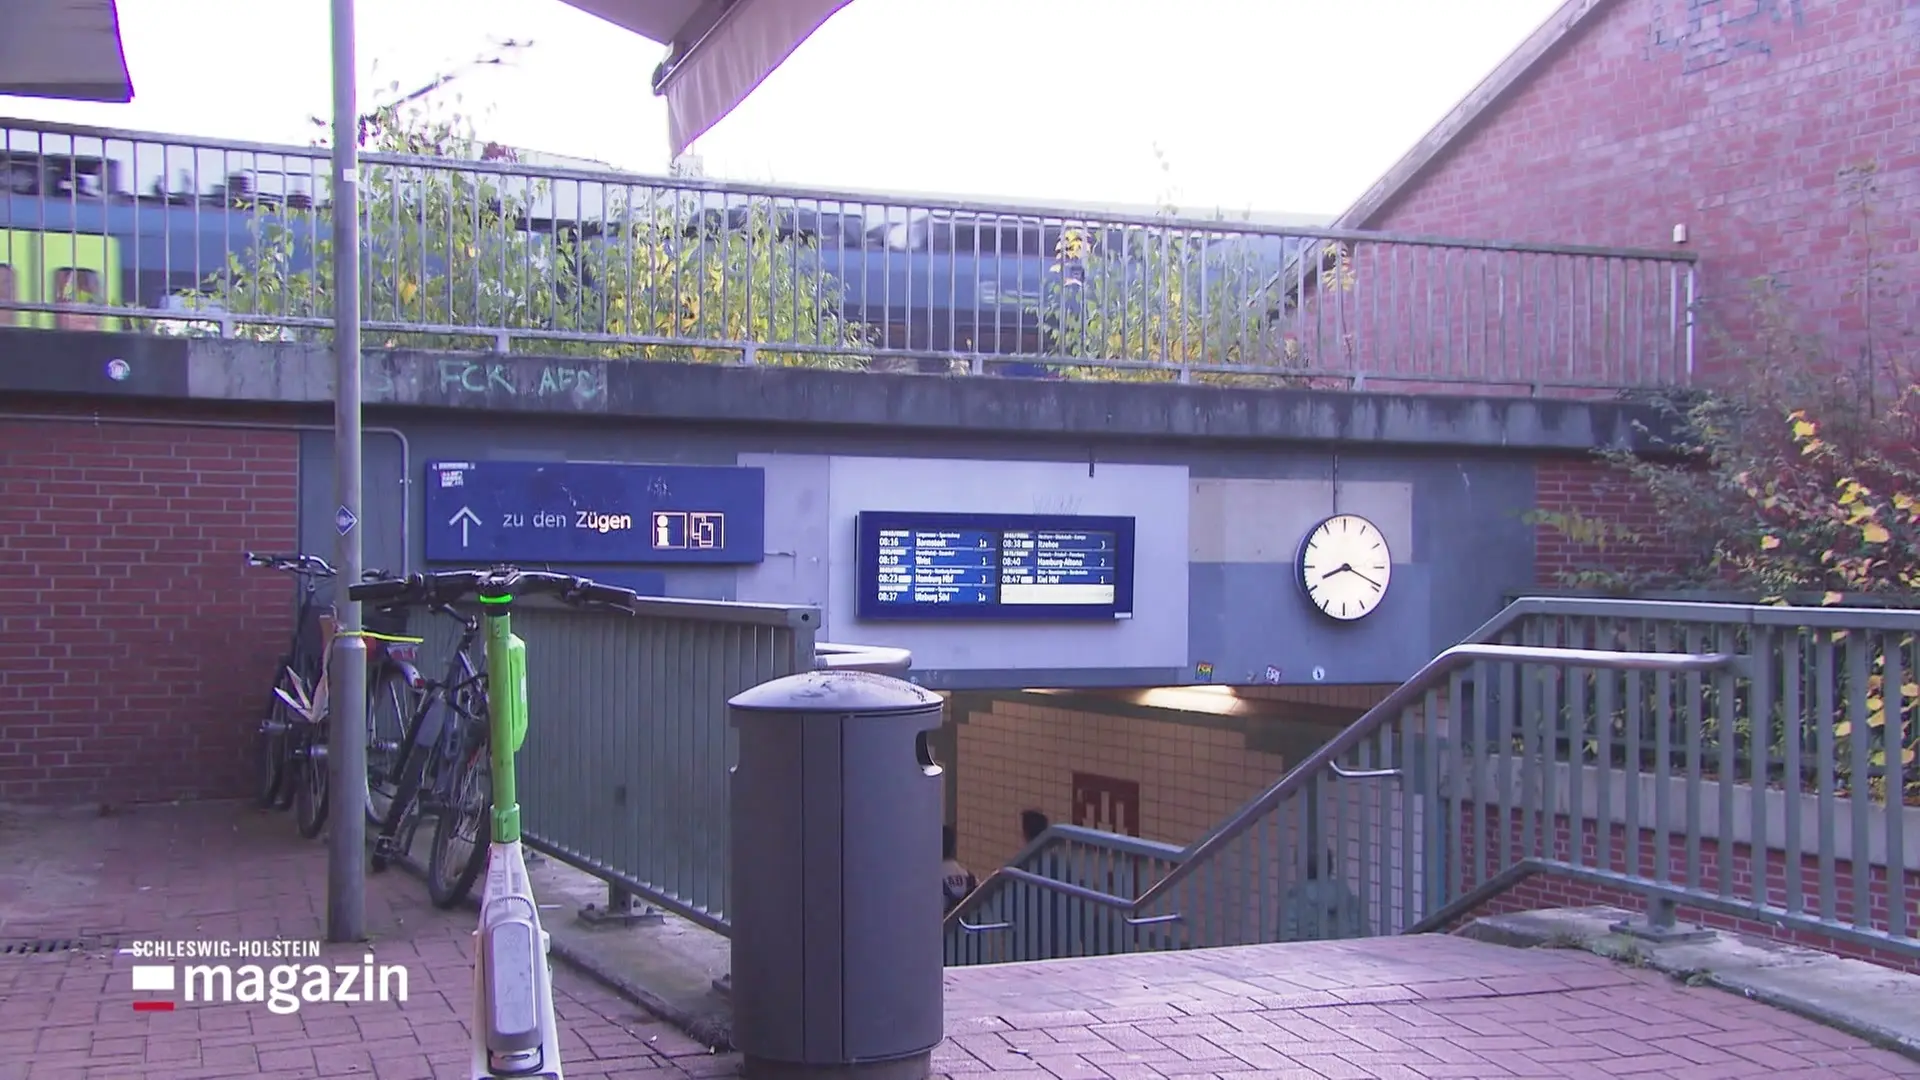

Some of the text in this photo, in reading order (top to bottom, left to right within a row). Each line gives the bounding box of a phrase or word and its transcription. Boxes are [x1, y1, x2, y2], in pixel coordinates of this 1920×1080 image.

[438, 359, 517, 395] FCK
[503, 510, 631, 532] zu den Zügen
[879, 537, 899, 547] 08:16
[878, 556, 898, 565] 08:19
